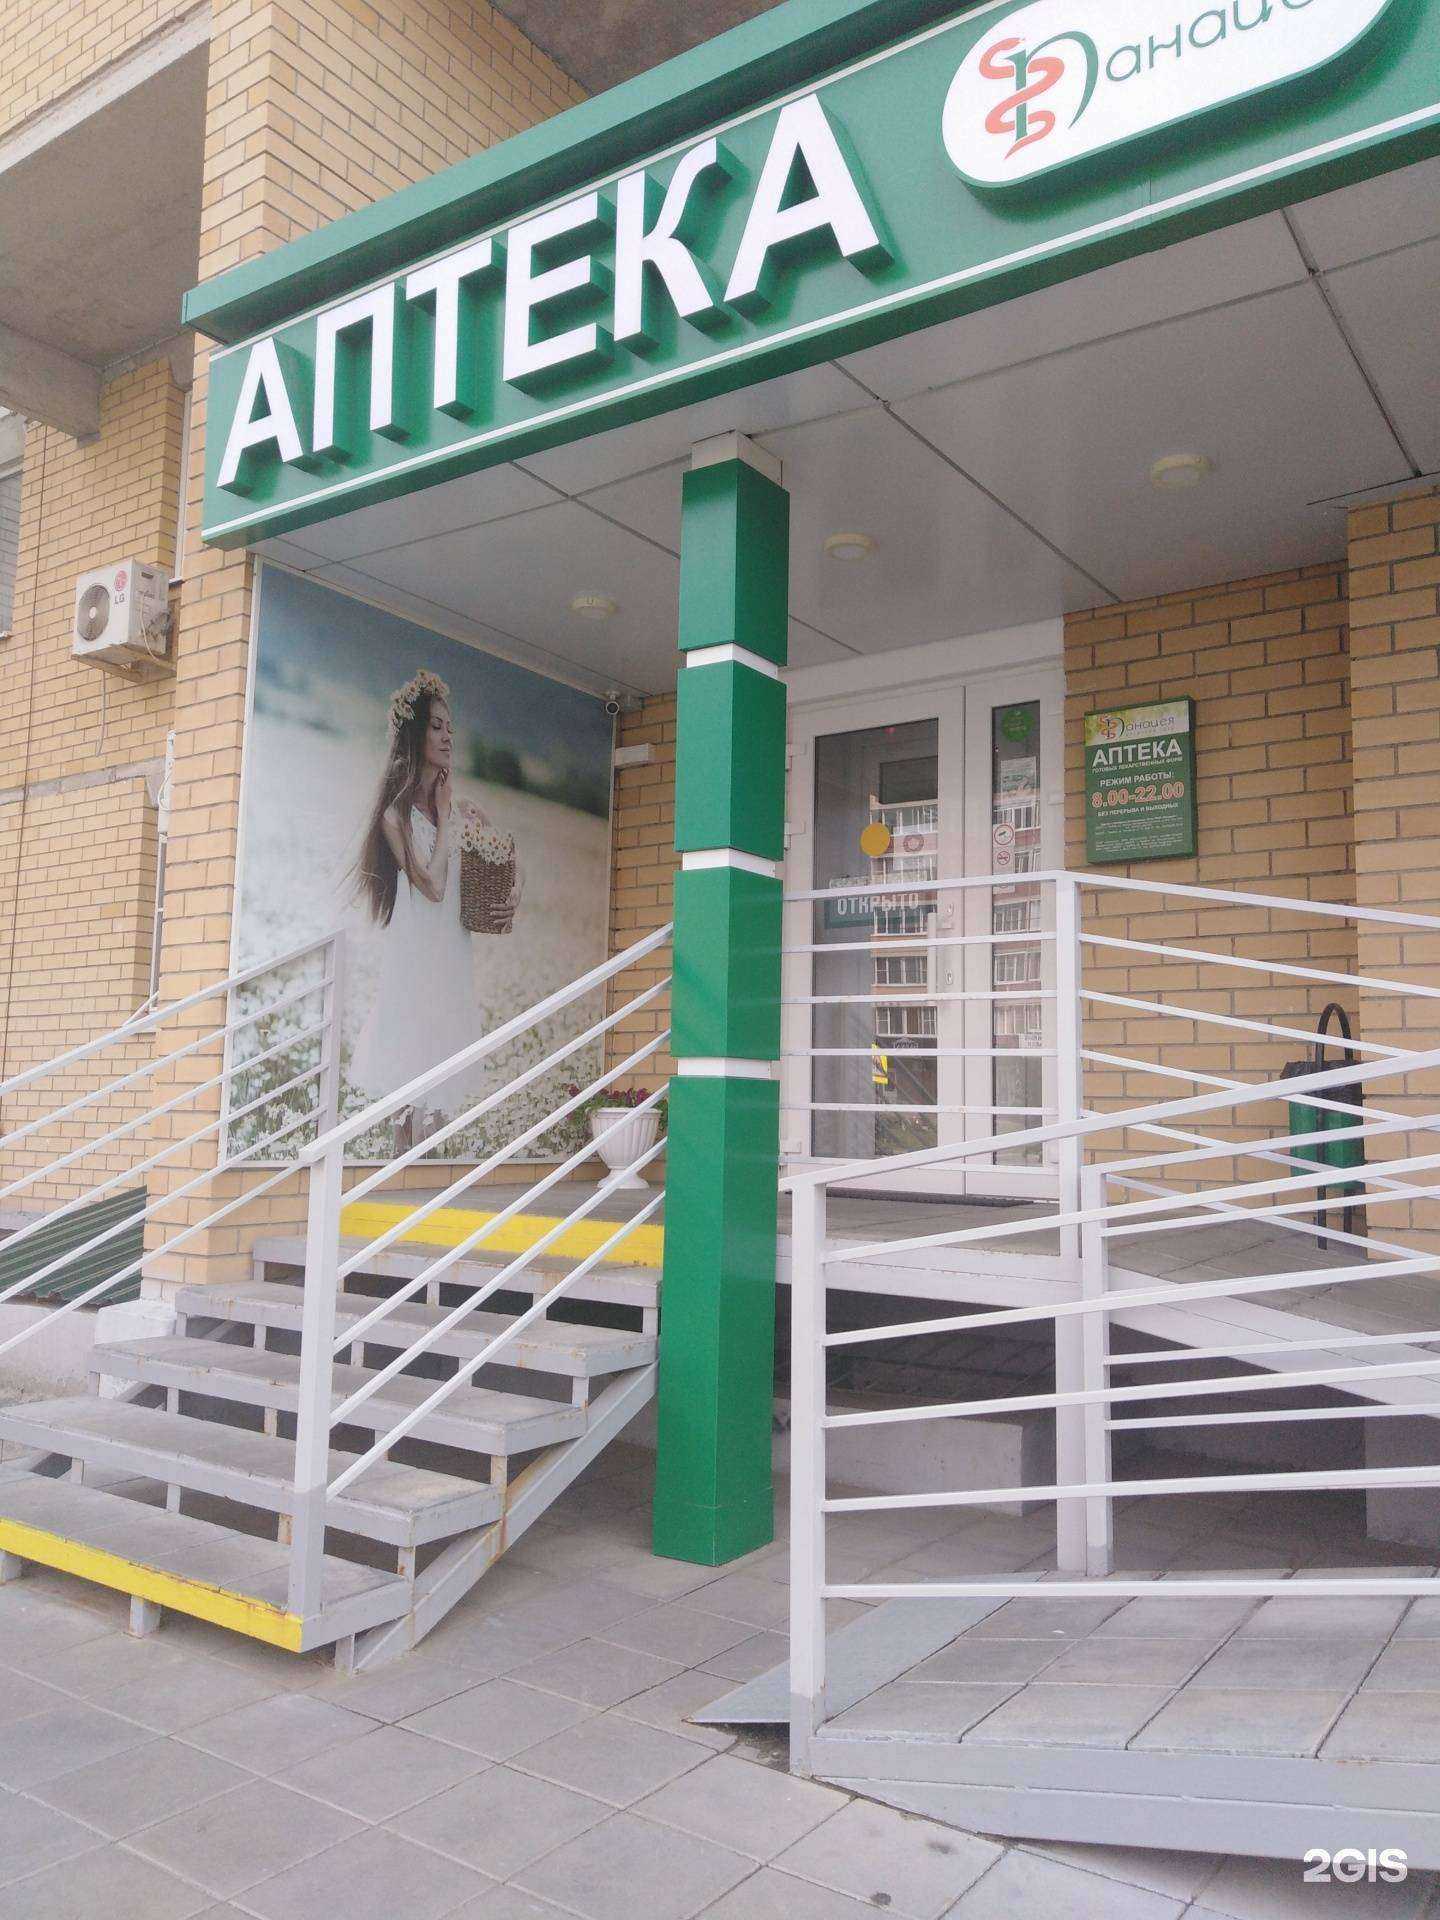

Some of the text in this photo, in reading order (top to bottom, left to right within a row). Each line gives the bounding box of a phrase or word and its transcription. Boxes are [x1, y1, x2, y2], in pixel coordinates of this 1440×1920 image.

[216, 93, 880, 489] АПТЕКА
[114, 593, 125, 605] LG
[1092, 738, 1182, 768] АПТЕКА
[1100, 771, 1174, 788] РЕЖИМ РАБОТЫ:
[1091, 782, 1184, 808] 8.00-22.00
[837, 892, 919, 915] ОТКРЫТО
